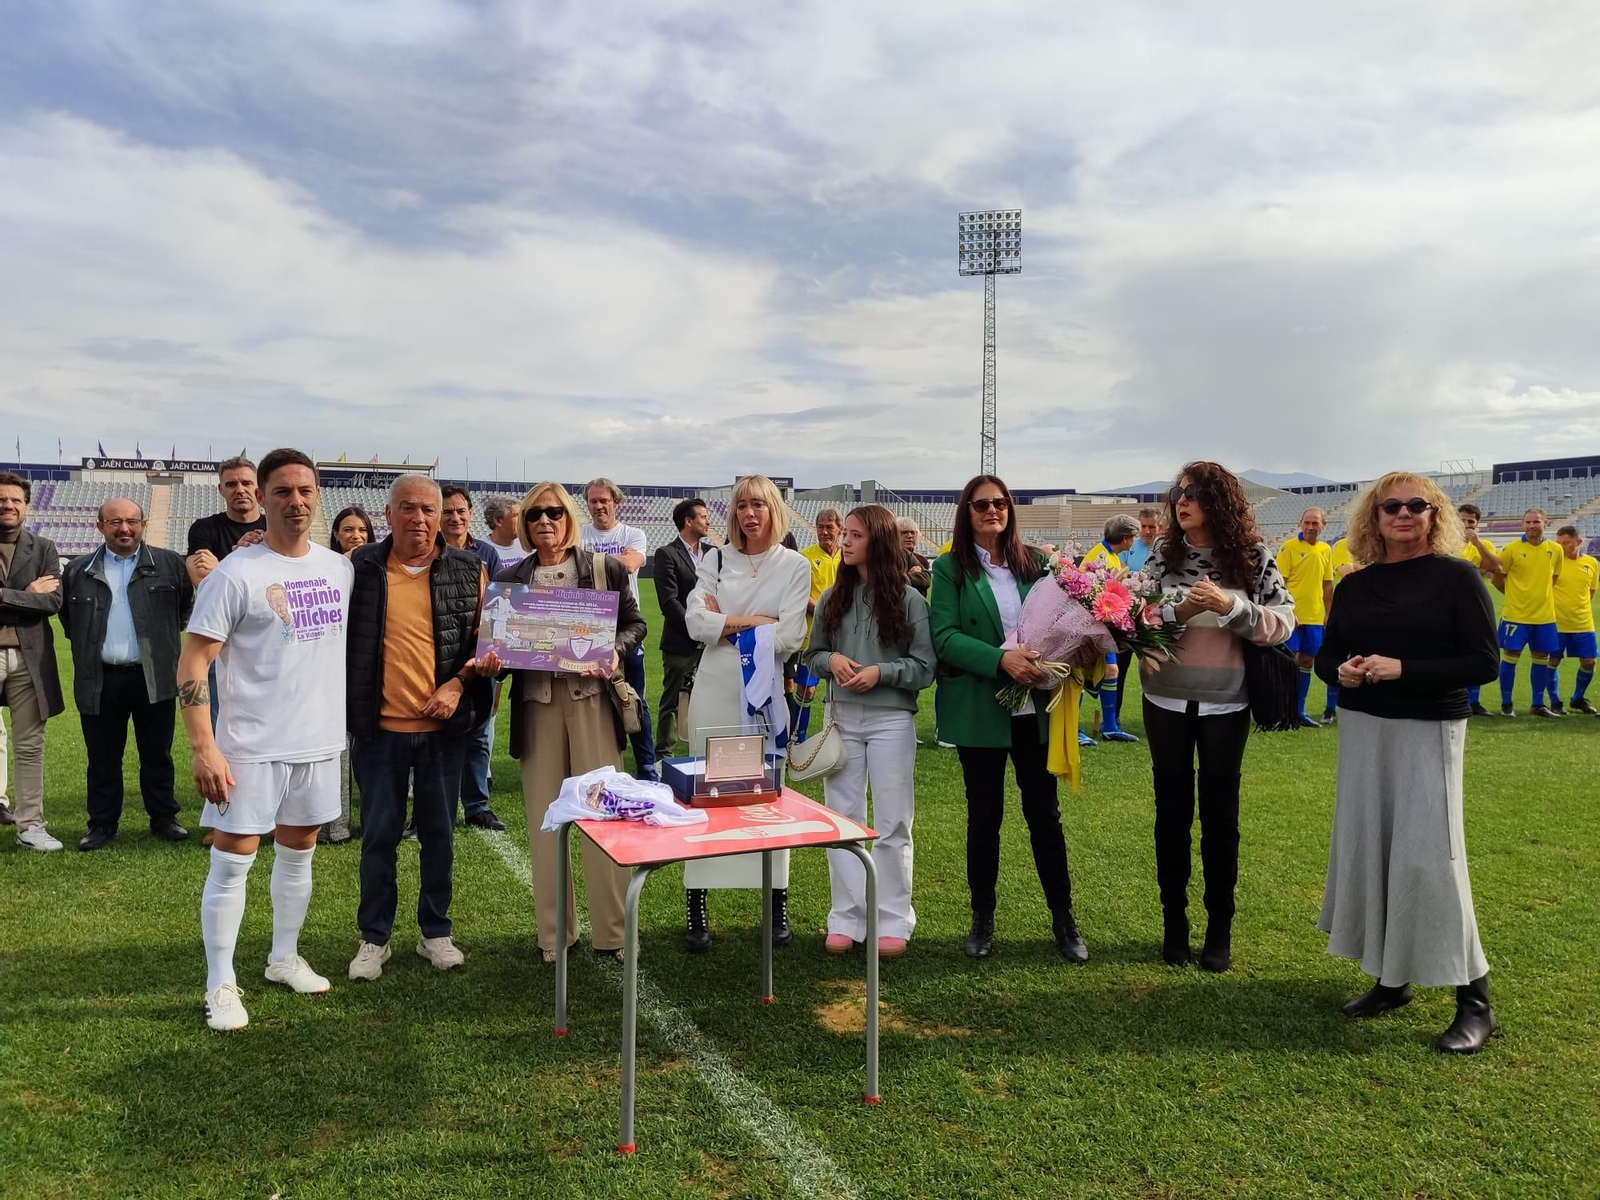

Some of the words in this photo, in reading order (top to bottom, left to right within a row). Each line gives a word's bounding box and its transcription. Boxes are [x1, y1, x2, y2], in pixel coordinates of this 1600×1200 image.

[100, 459, 121, 468] JAÉN
[124, 461, 148, 469] CLIMA
[169, 462, 190, 470] JAÉN
[192, 463, 215, 471] CLIMA
[284, 577, 327, 590] Homenaje
[287, 586, 341, 609] Higinio
[555, 589, 585, 600] Higinio
[585, 590, 615, 602] Vilches
[292, 607, 343, 629] Vilches
[1505, 623, 1518, 637] 17
